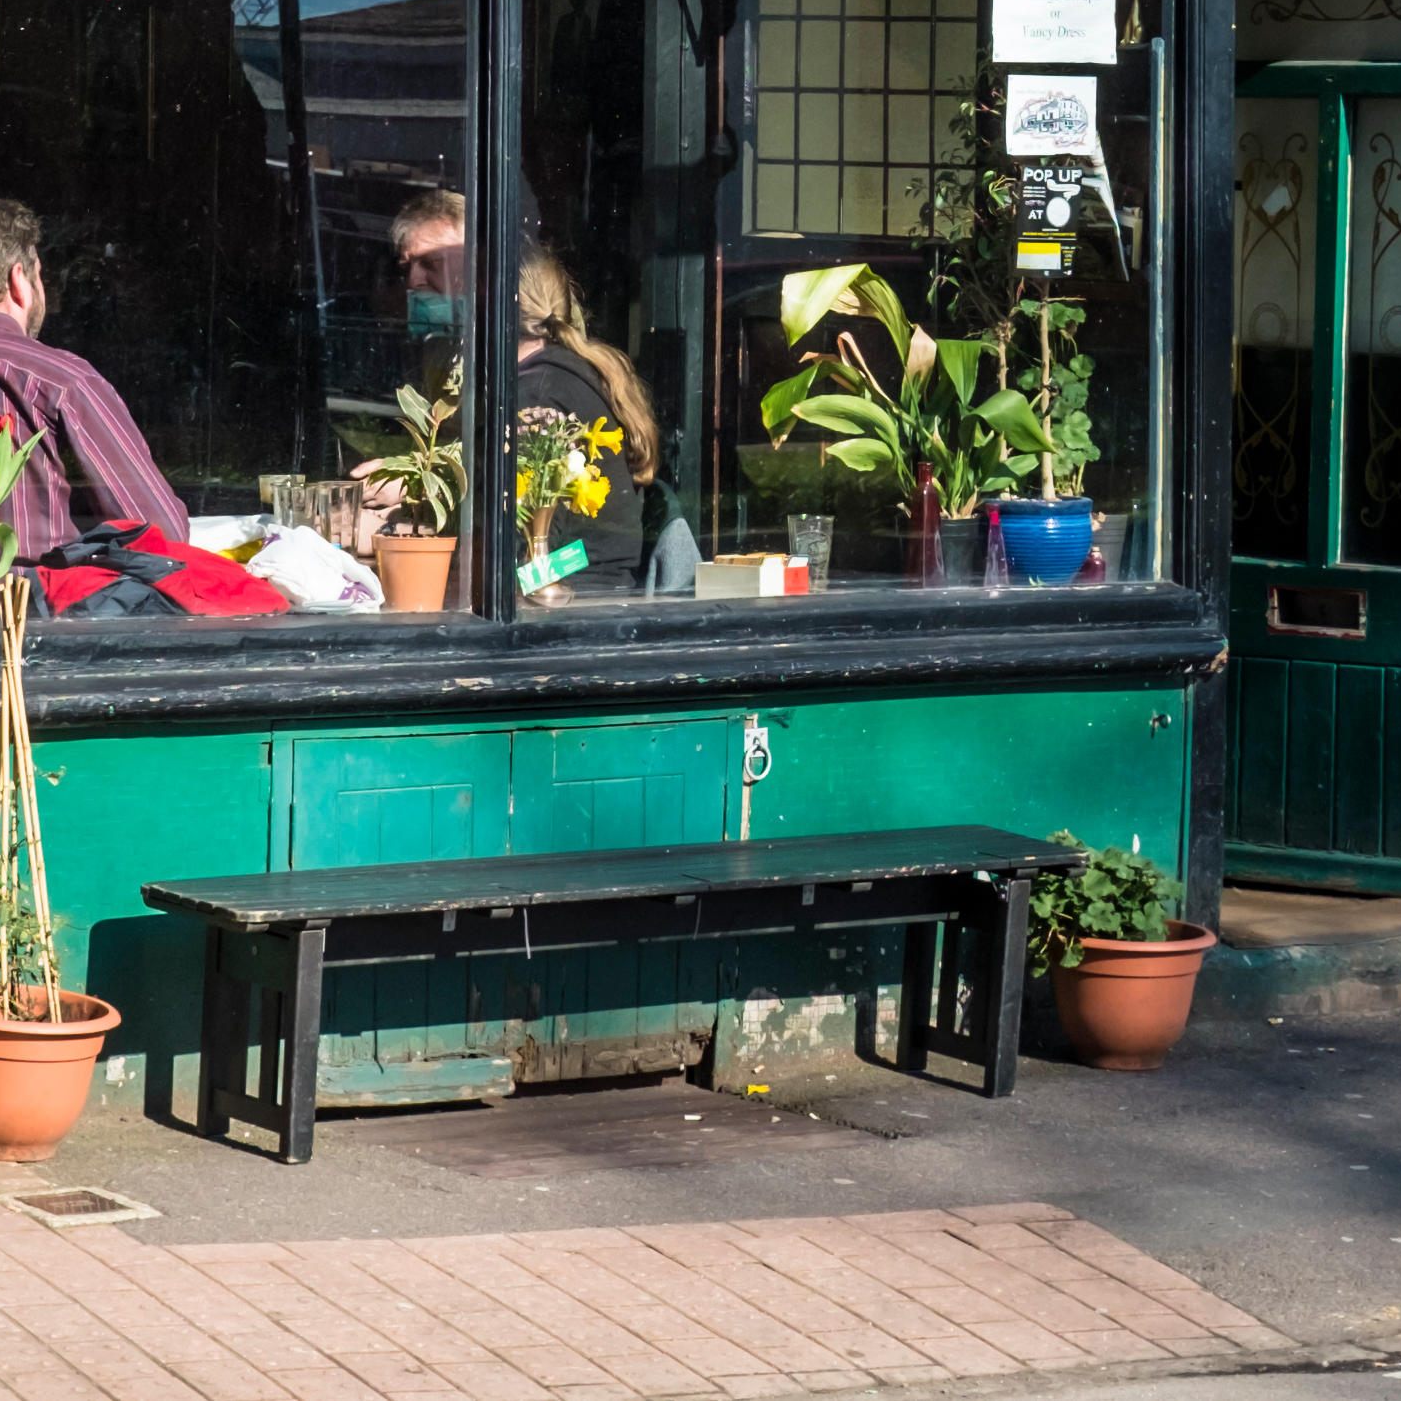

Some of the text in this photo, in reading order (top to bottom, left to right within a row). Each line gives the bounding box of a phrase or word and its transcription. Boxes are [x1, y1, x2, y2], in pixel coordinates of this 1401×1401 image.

[1022, 25, 1086, 40] Fancy Dress
[1022, 167, 1083, 183] POP UP
